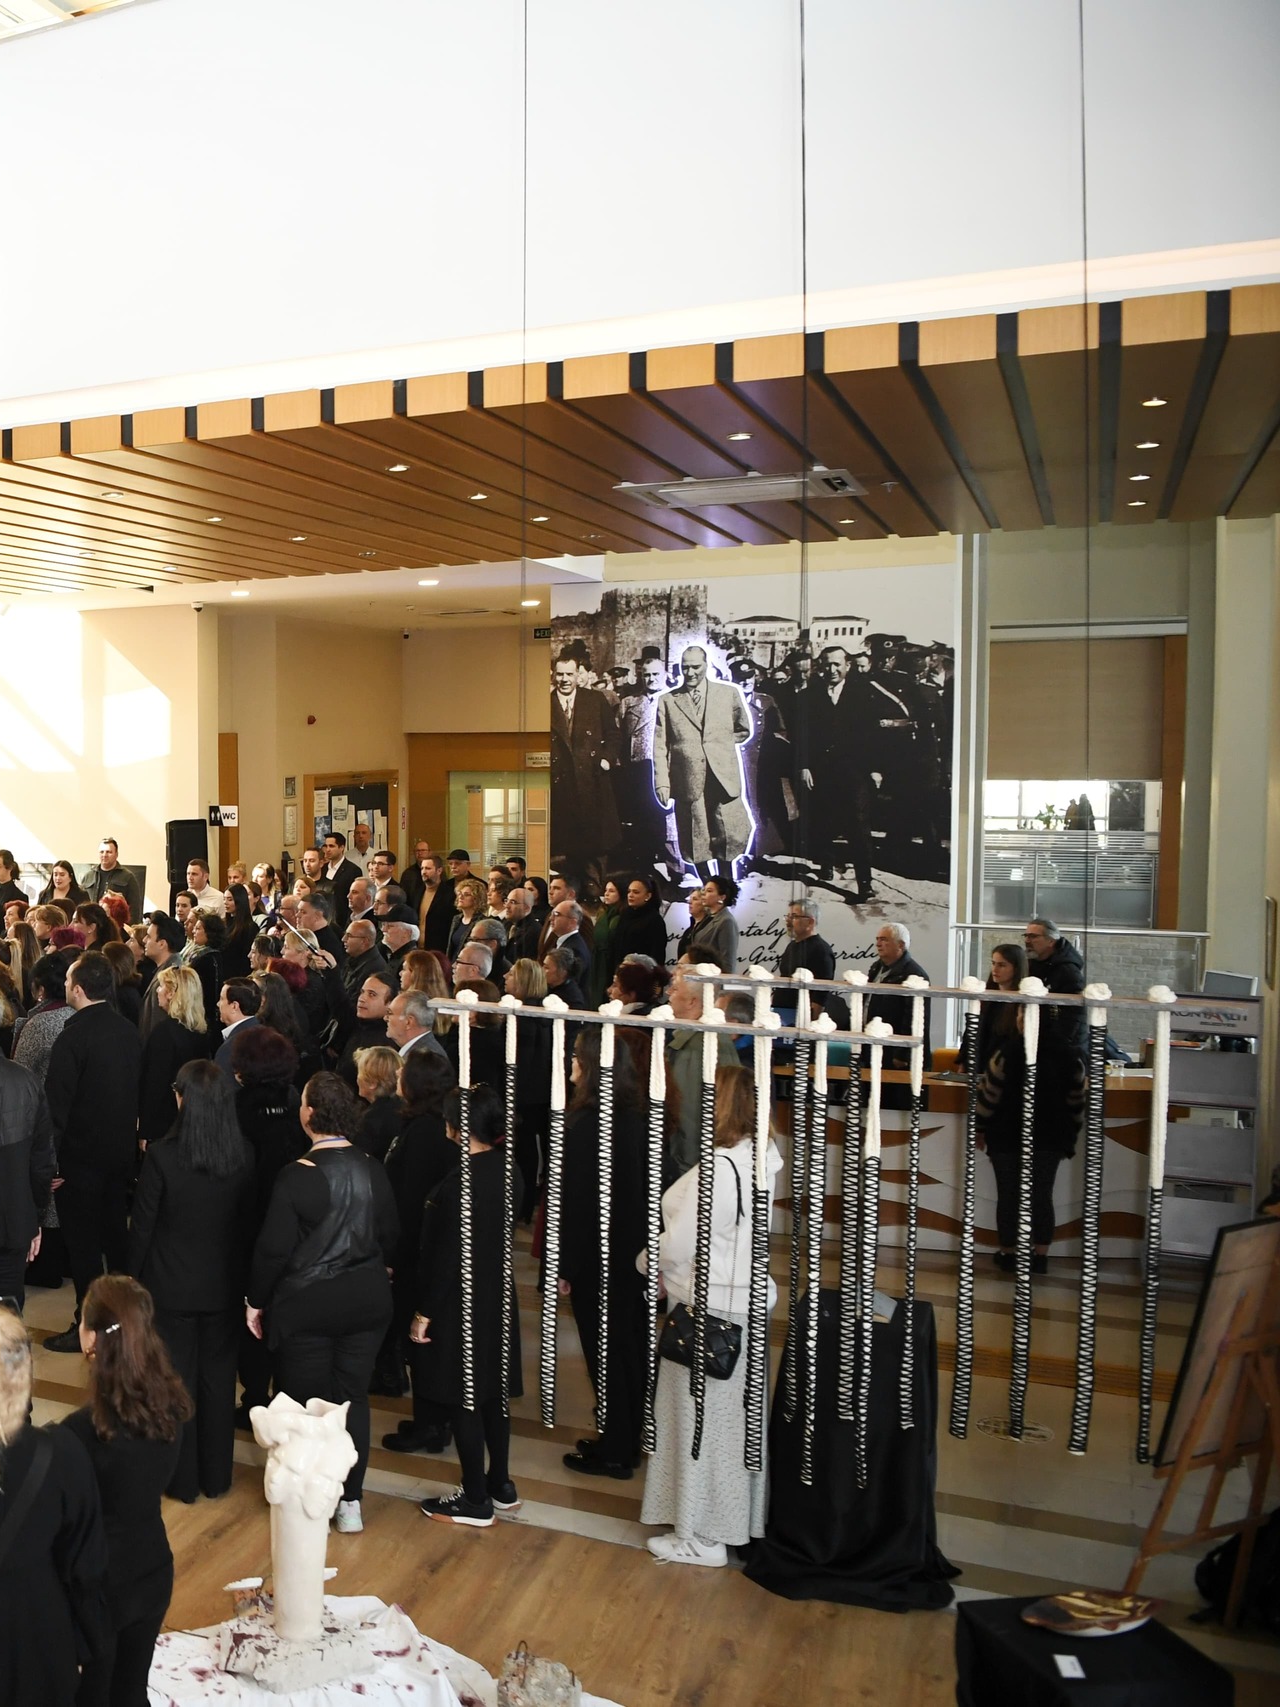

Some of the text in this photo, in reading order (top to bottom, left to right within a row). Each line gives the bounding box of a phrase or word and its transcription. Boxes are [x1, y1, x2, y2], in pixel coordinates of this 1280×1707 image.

[222, 812, 236, 820] WC
[739, 918, 787, 950] ntaly
[743, 945, 782, 975] Güz
